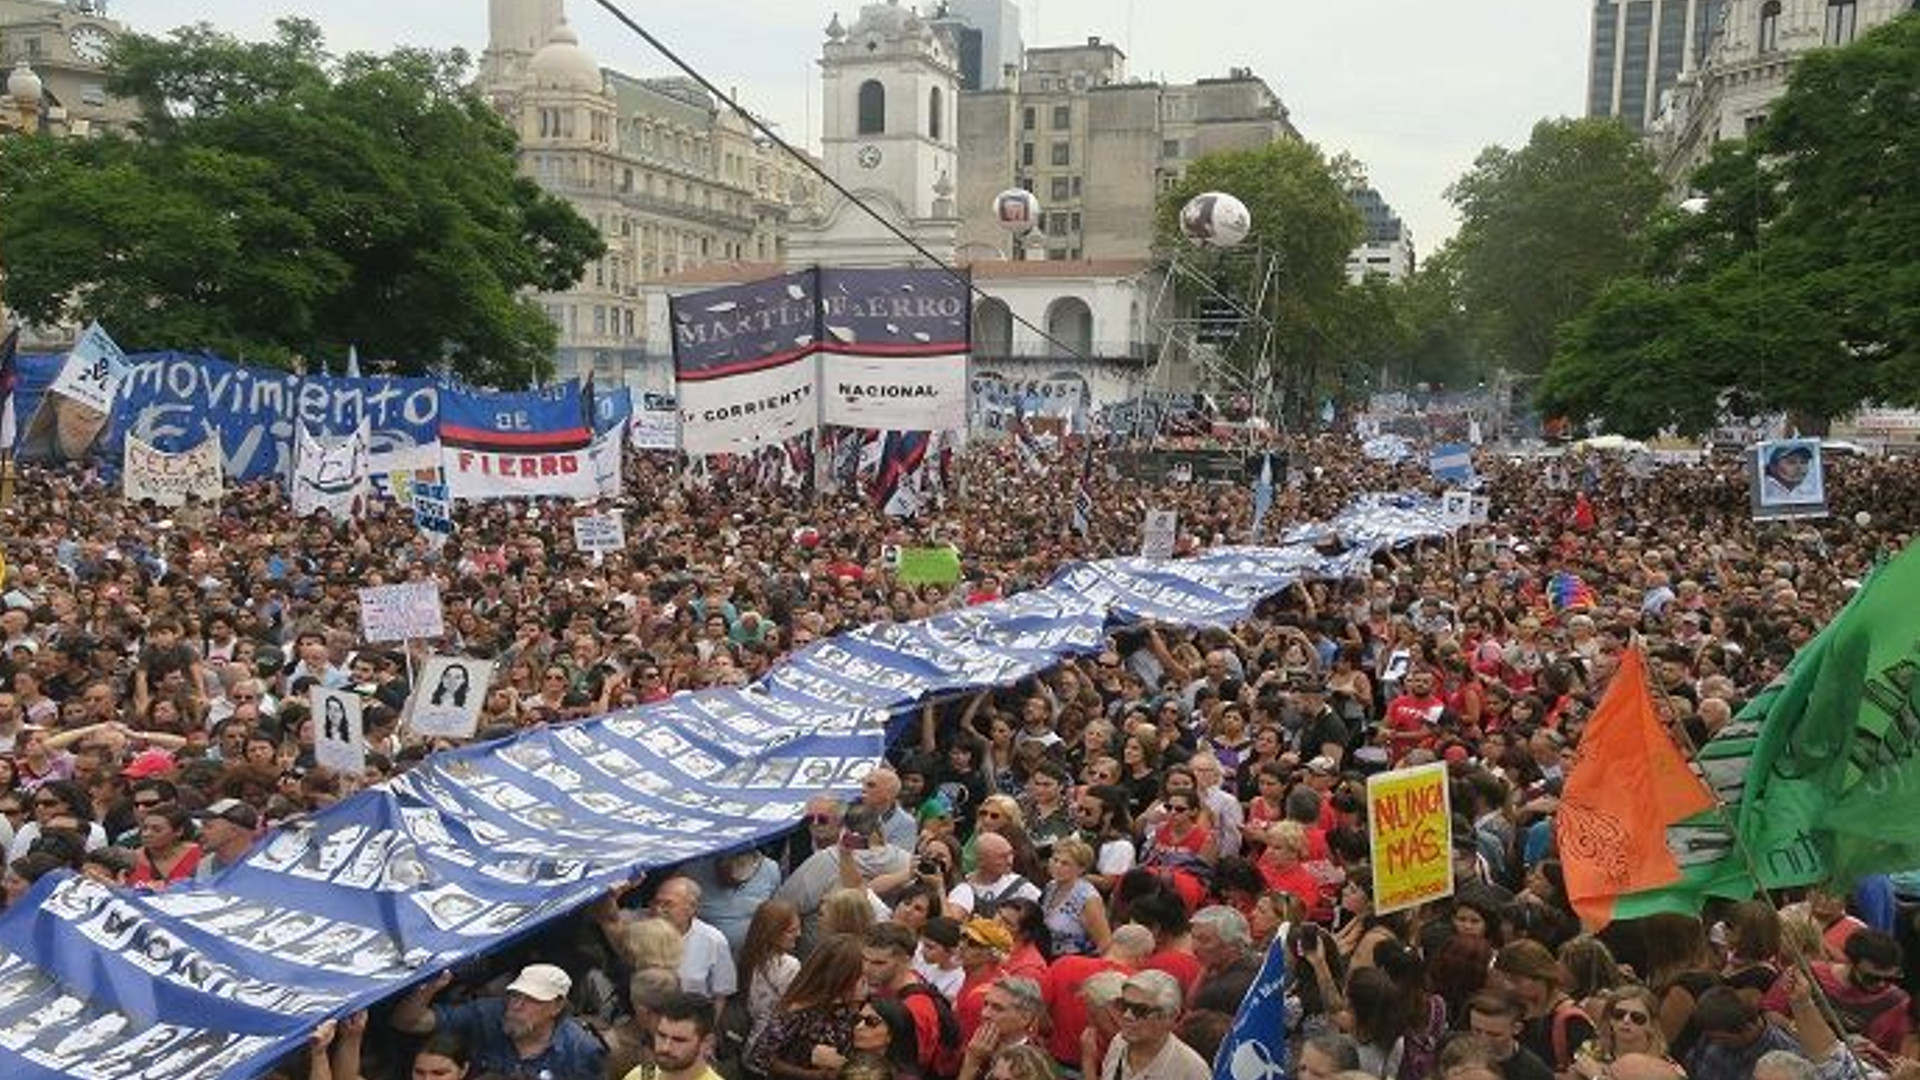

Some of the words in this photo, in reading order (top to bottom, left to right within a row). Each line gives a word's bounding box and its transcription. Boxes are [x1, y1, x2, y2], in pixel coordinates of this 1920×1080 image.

[839, 383, 938, 398] NACIONAL
[458, 453, 579, 478] FIERRO
[1375, 783, 1444, 835] NUNCA
[1386, 817, 1441, 875] MÁS
